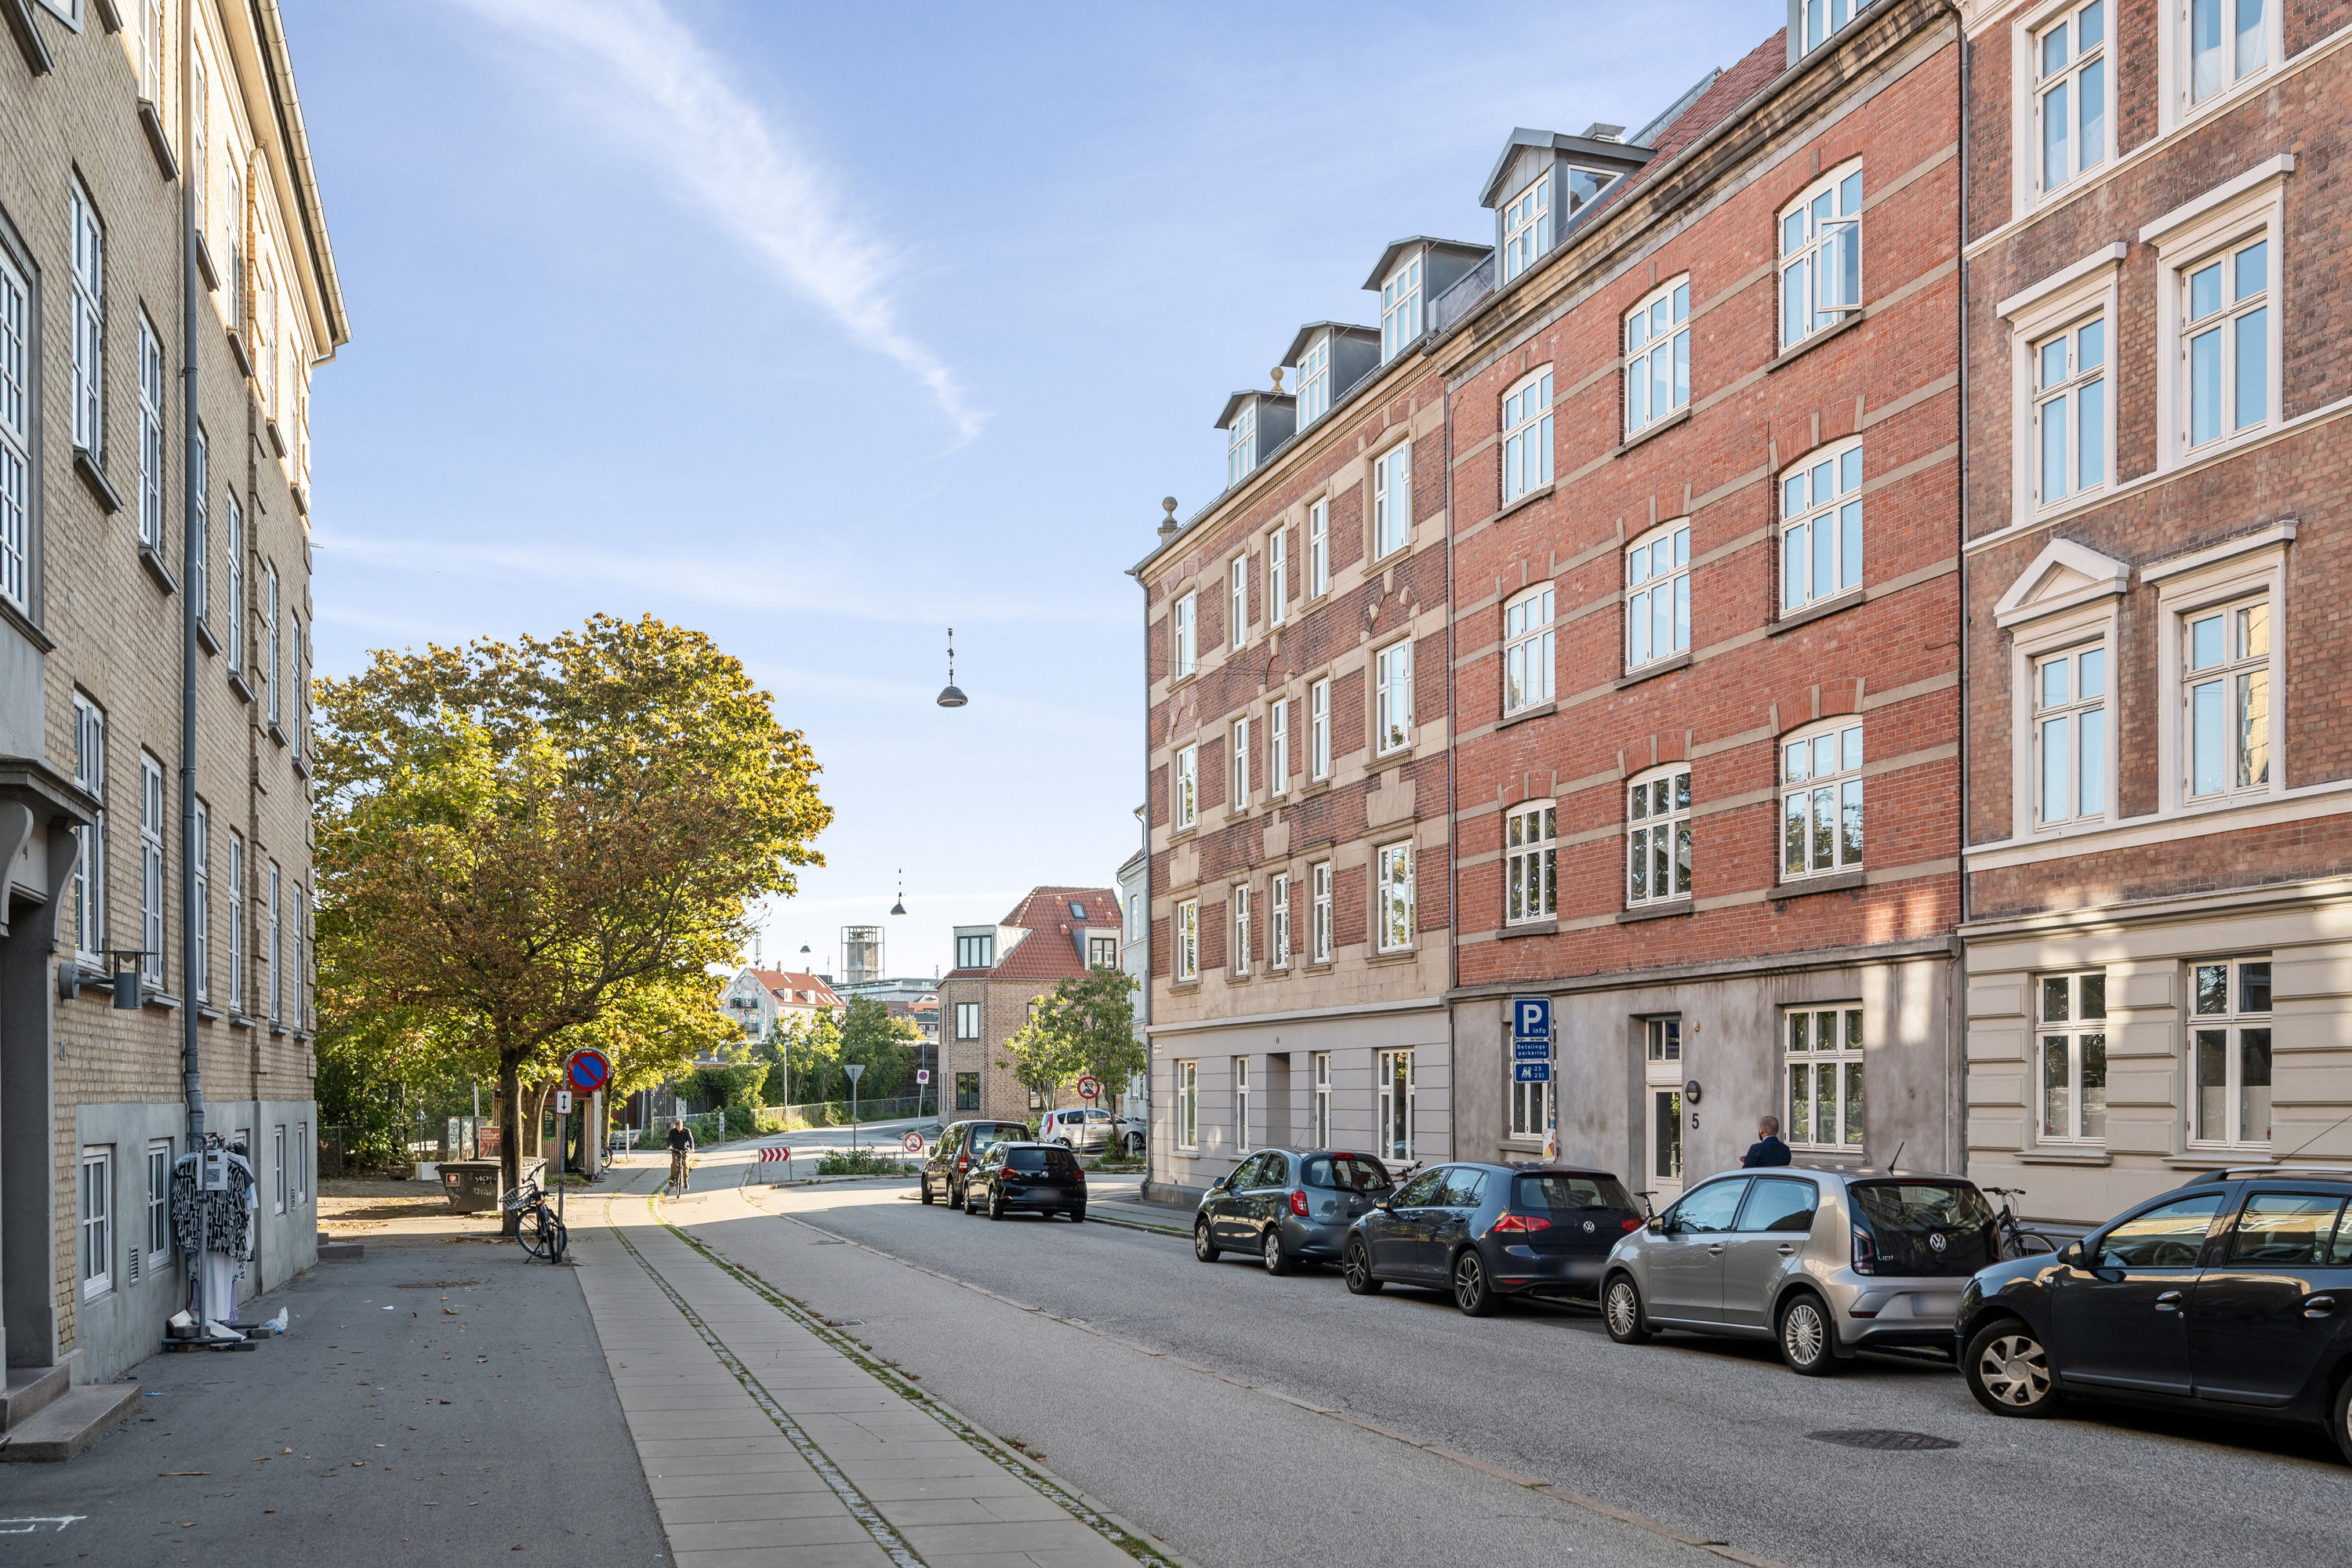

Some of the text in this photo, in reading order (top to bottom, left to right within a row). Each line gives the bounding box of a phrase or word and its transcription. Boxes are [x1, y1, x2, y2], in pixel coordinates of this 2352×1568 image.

[1523, 1004, 1542, 1033] P
[1692, 1112, 1700, 1130] 5
[1930, 1233, 1946, 1251] VW
